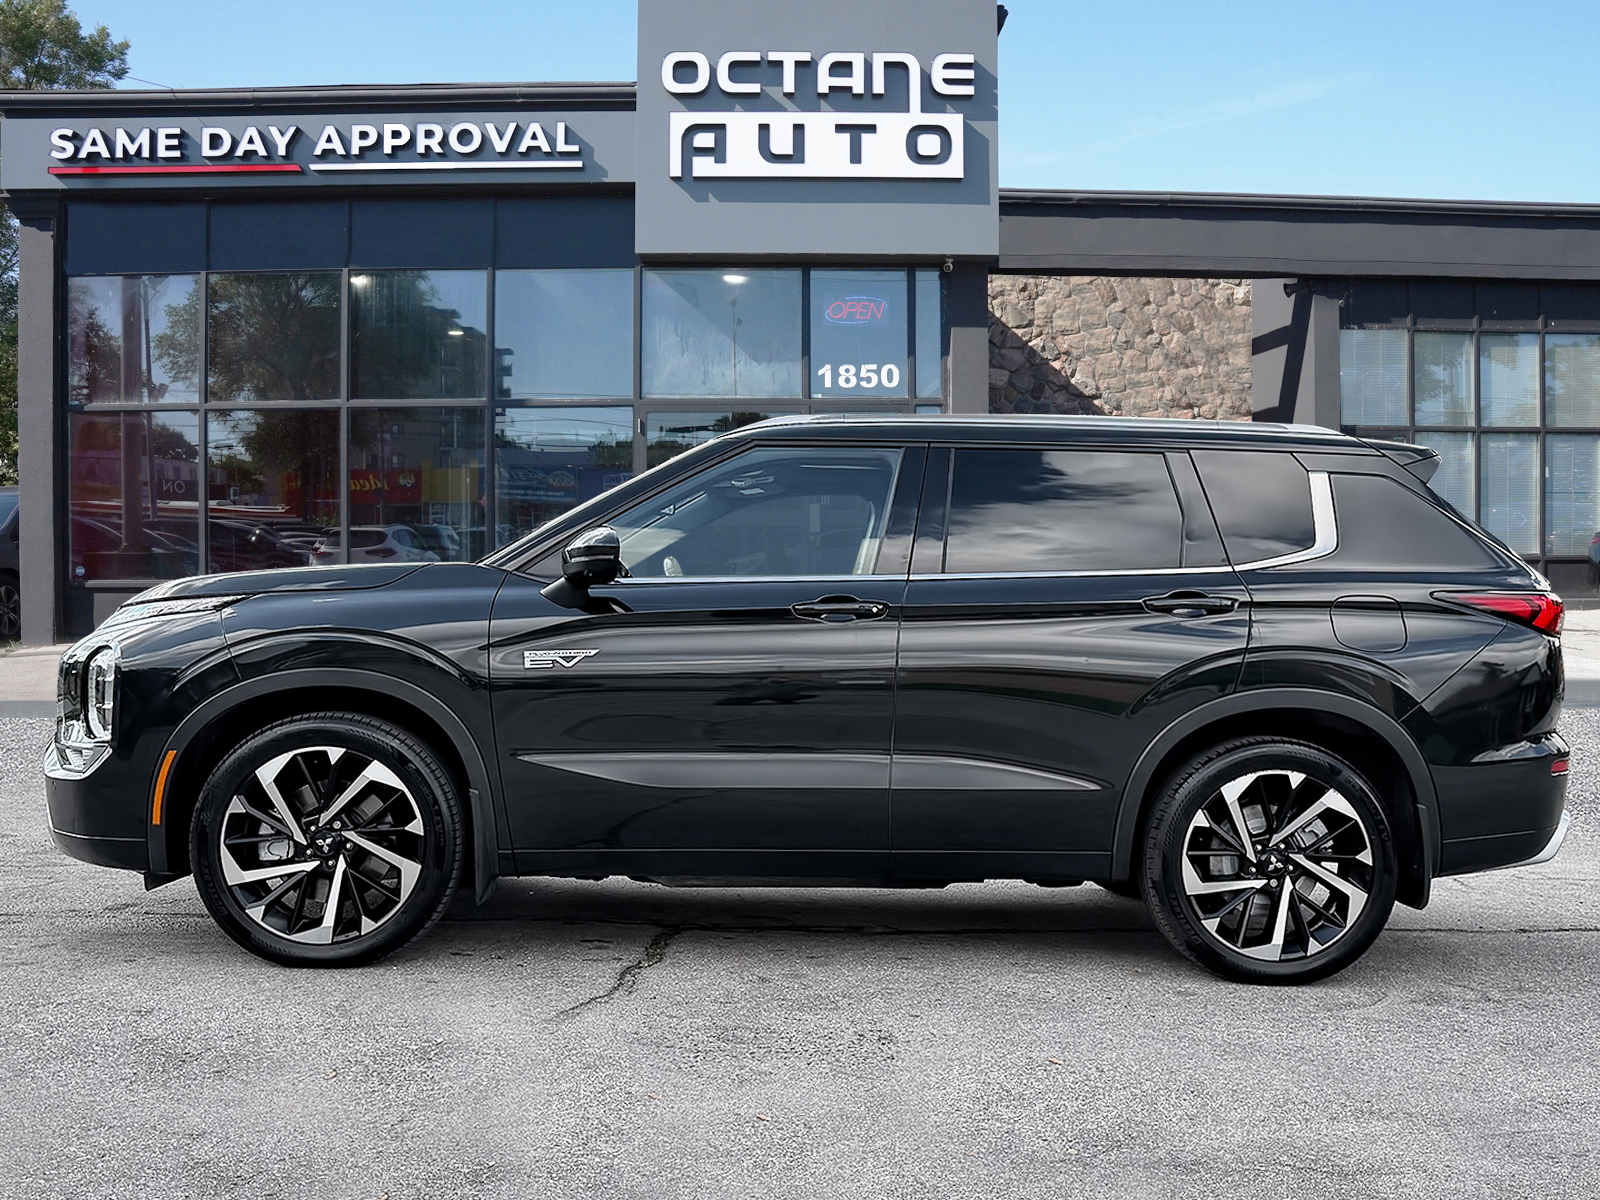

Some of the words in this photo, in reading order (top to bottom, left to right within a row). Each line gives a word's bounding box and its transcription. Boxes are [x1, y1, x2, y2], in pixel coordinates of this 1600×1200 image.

[661, 51, 976, 97] OCTANE
[49, 127, 182, 161] SAME
[201, 124, 299, 158] DAY
[312, 121, 581, 157] APPROVAL
[681, 123, 953, 177] AUTO
[828, 301, 885, 320] OPEN
[817, 363, 900, 389] 1850
[524, 656, 586, 669] EV
